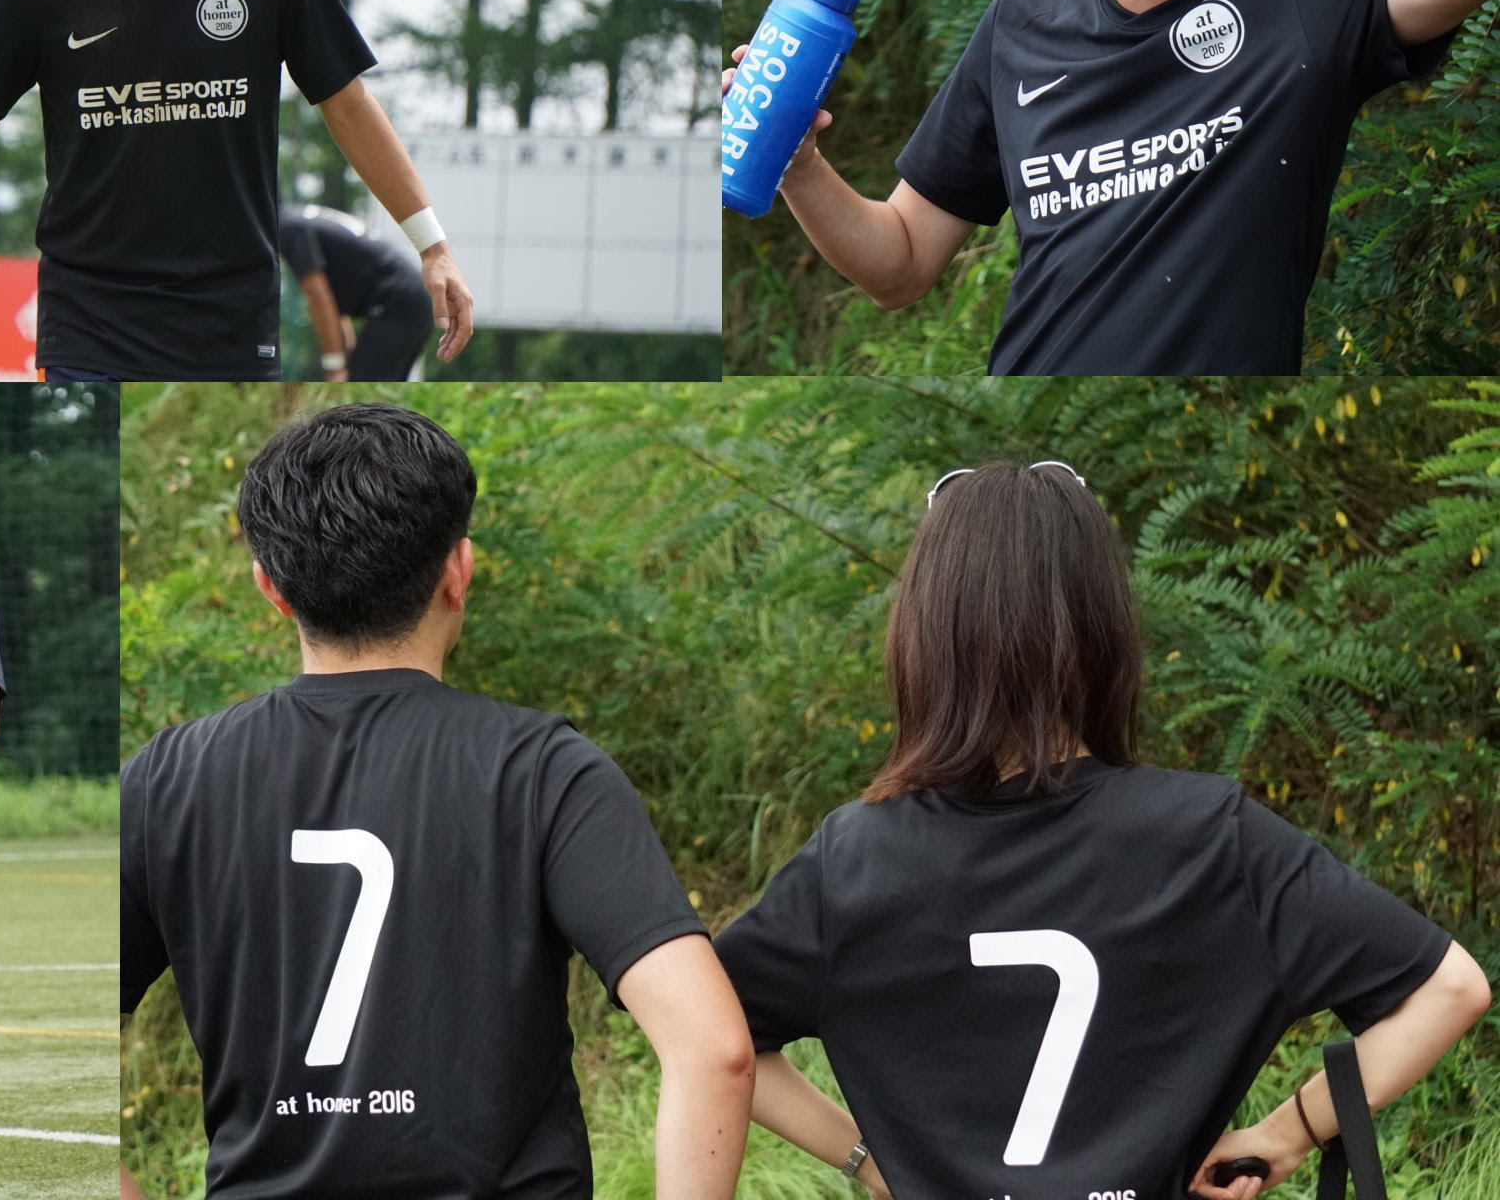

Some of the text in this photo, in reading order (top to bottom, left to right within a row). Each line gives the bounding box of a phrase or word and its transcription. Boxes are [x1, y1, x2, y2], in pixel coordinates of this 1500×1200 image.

[203, 8, 242, 21] homer
[215, 21, 233, 31] 2016
[1195, 8, 1214, 29] at
[1179, 20, 1235, 49] homer
[1201, 41, 1226, 60] 2016
[77, 76, 249, 109] EVE SPORTS
[722, 21, 779, 145] SWEA
[79, 96, 248, 131] eve-kashiwa.co.jp
[1019, 105, 1244, 189] EVE SPORTS
[290, 828, 395, 1067] 7
[970, 929, 1101, 1166] 7
[276, 1096, 299, 1115] at
[368, 1089, 416, 1114] 2016
